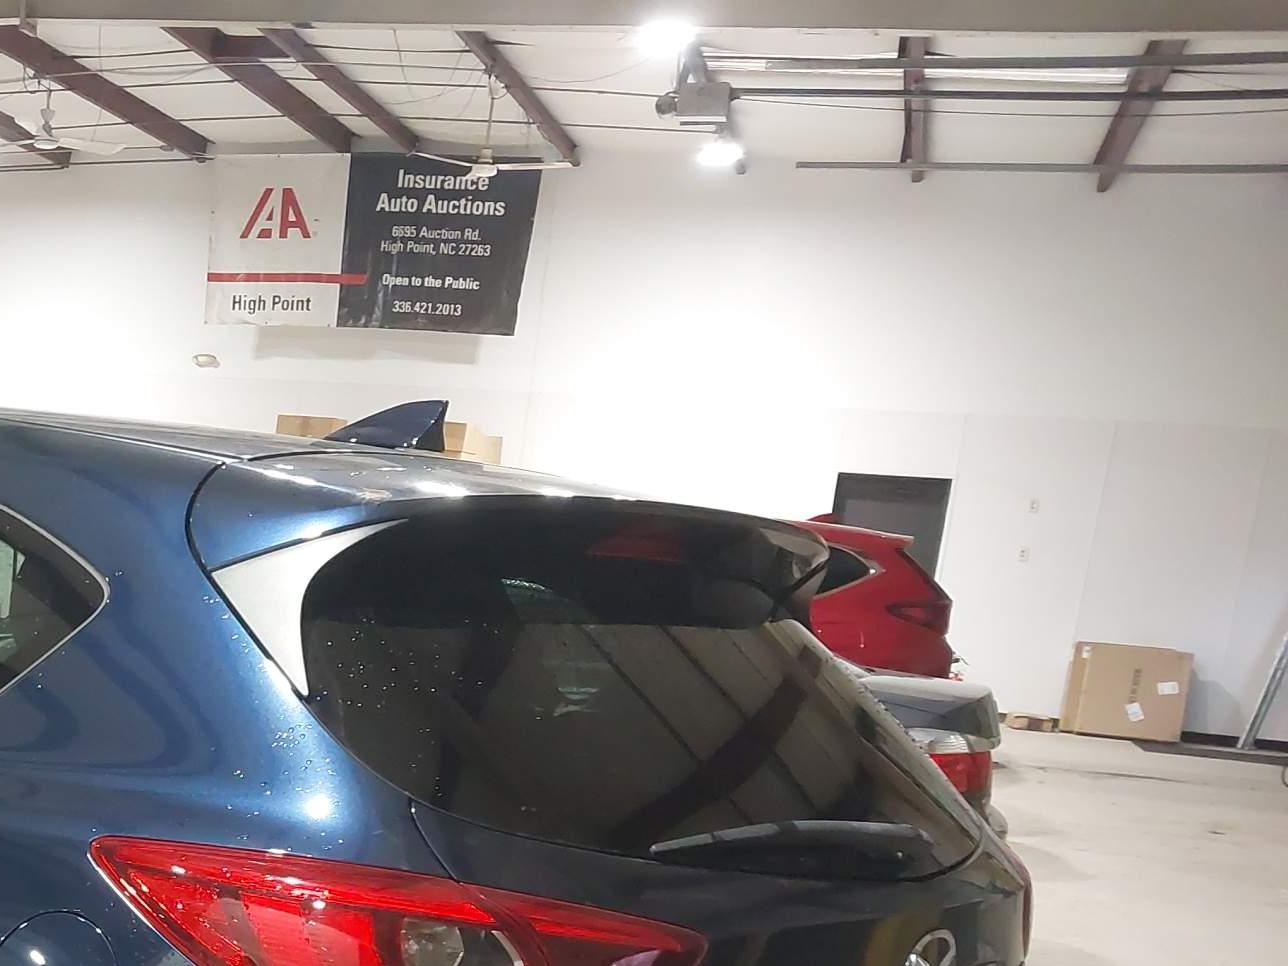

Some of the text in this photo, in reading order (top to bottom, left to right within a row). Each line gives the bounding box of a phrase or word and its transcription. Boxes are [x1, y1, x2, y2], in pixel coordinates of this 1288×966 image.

[397, 168, 489, 191] Insurance
[375, 192, 506, 216] Auto Auctions
[419, 226, 462, 239] Auction
[464, 228, 482, 241] Rd.
[380, 240, 492, 257] High Point, NC 27263
[382, 273, 481, 290] Open to the Public
[232, 294, 312, 315] High Point
[392, 300, 462, 316] 336.421.2013
